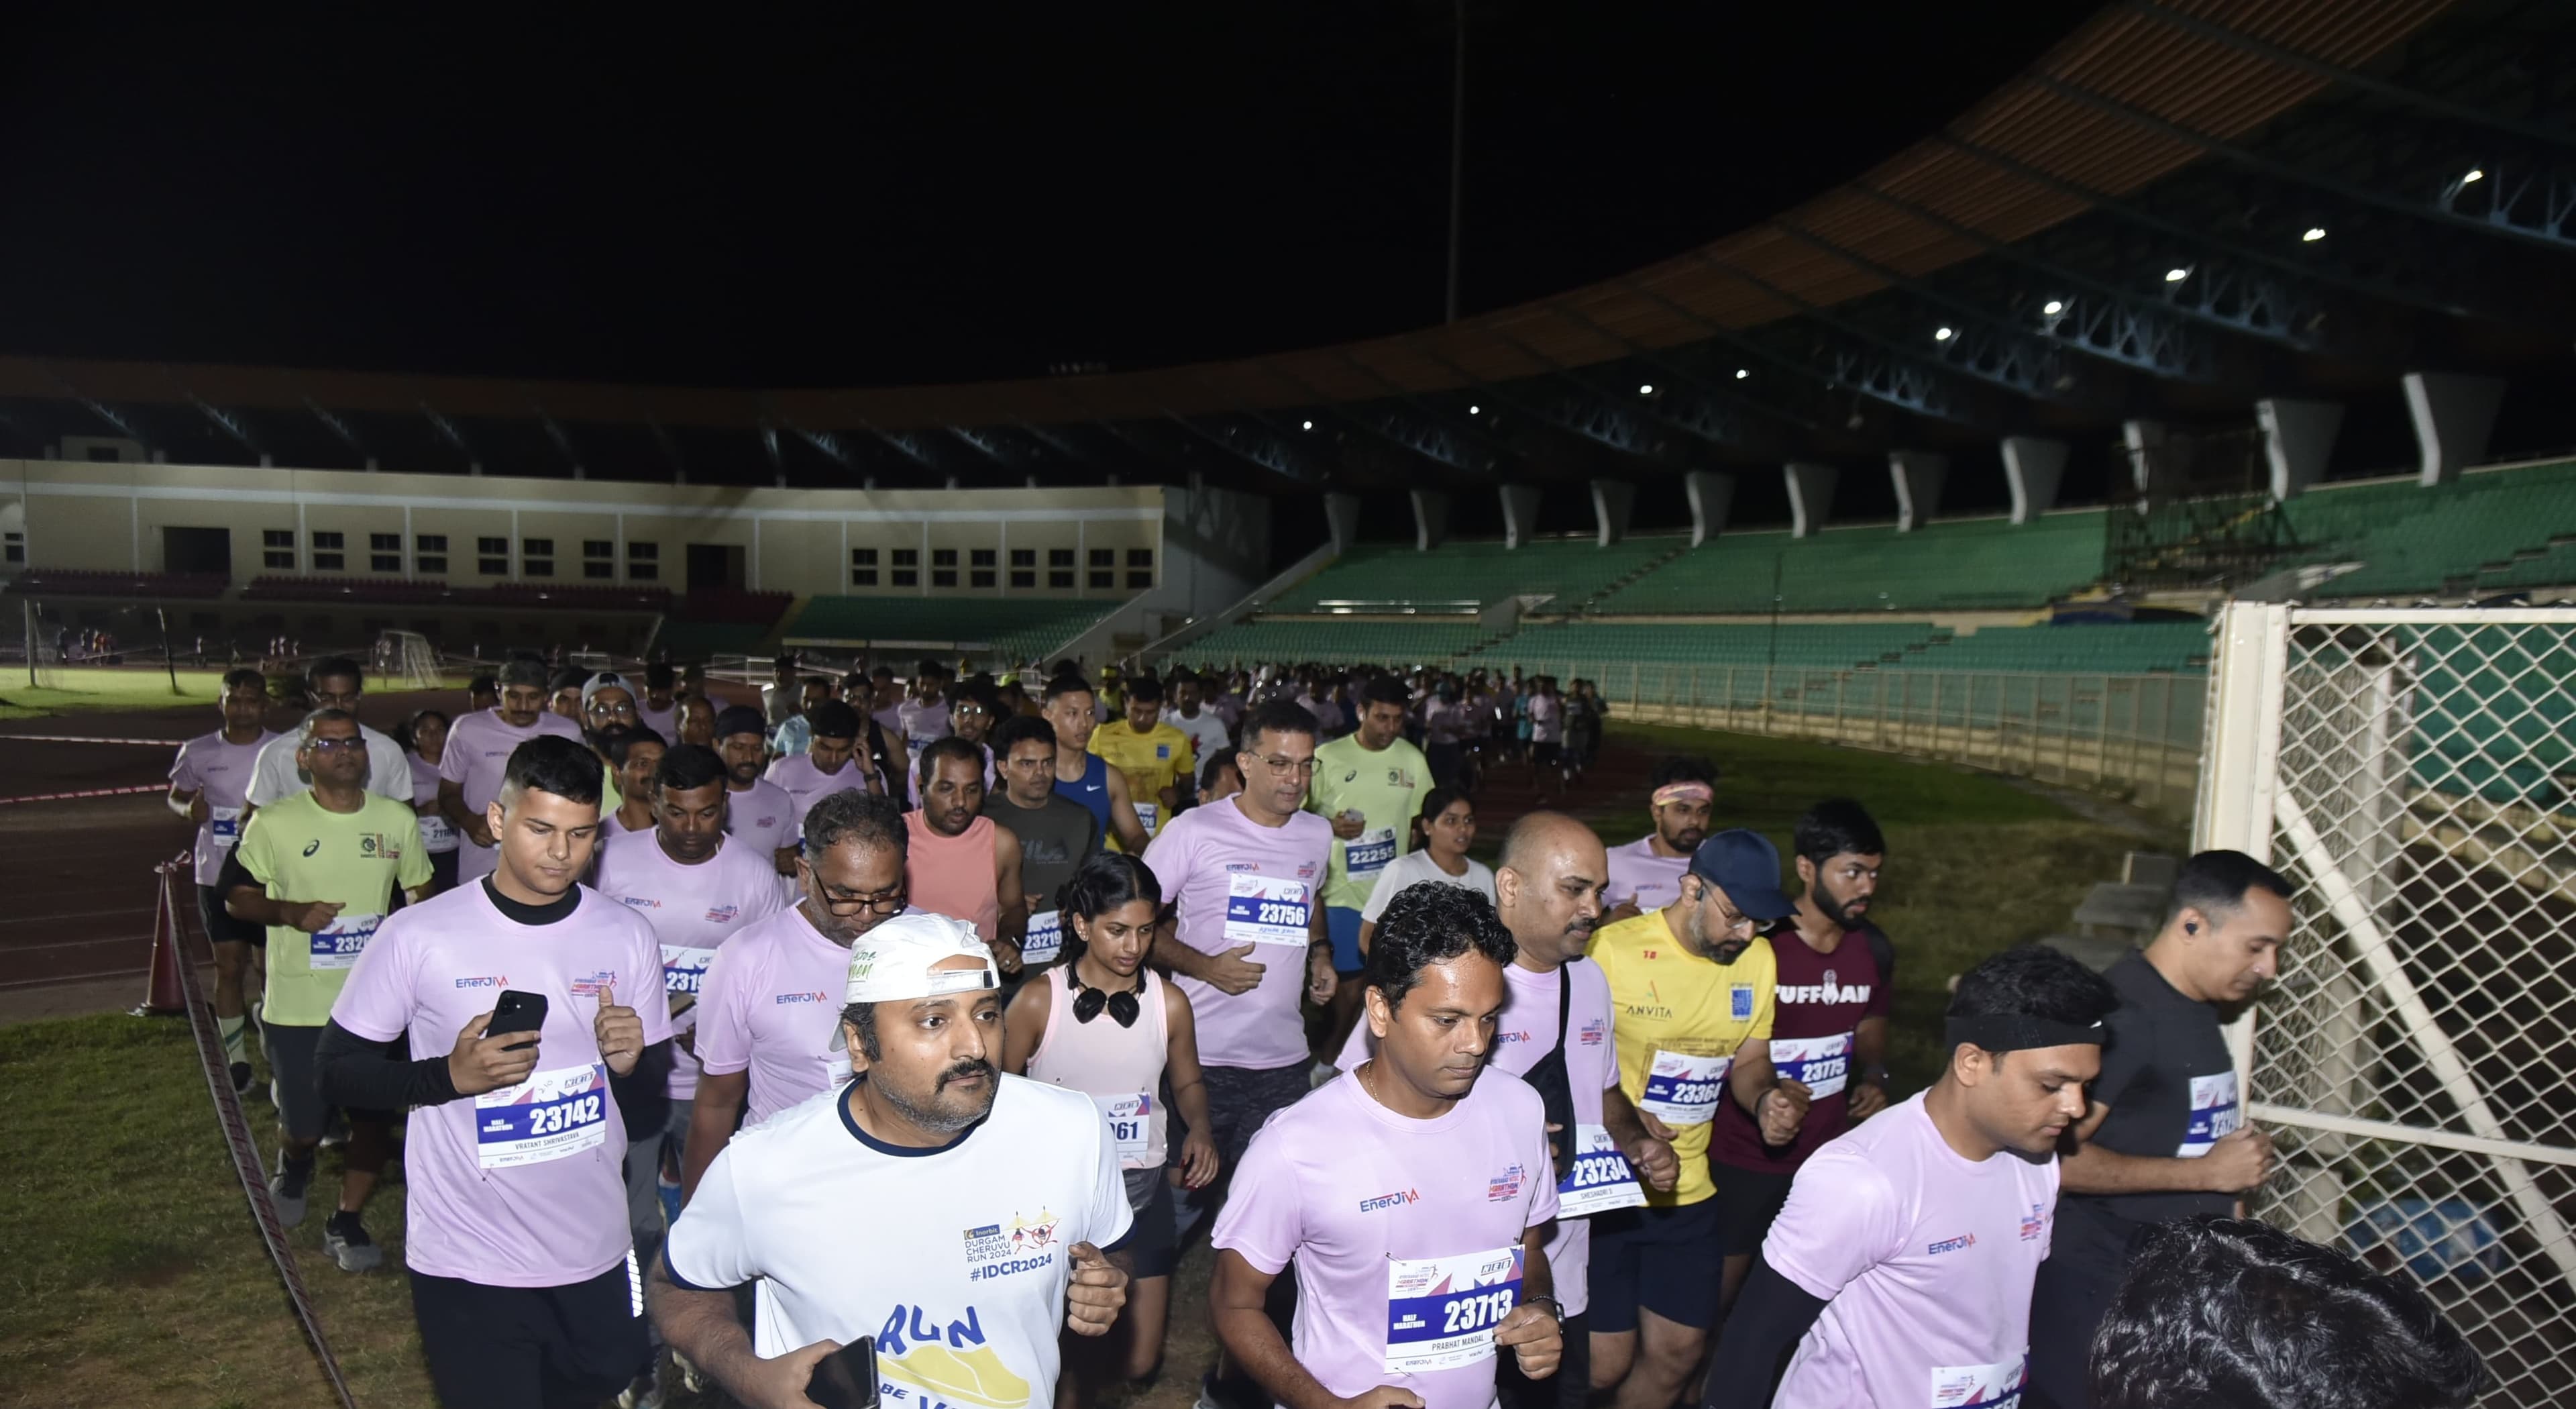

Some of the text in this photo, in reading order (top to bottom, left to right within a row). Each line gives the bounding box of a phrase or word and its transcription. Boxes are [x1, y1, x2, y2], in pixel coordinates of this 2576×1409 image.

[1350, 846, 1395, 865] 22255
[1258, 902, 1305, 926] 23756
[1024, 930, 1063, 949] 23219
[1626, 1005, 1672, 1019] ANVITA
[1801, 1057, 1846, 1082] 23775
[1671, 1082, 1723, 1104] 23364
[529, 1095, 600, 1135] 23742
[515, 1139, 542, 1150] VRATANT
[543, 1131, 580, 1147] SHRIVASTAVA
[1572, 1156, 1631, 1187] 23234
[975, 1227, 999, 1237] Inorbit
[965, 1235, 1006, 1249] DURGAM
[966, 1242, 1011, 1256] CHERUVU
[967, 1249, 1012, 1263] RUN 2024
[970, 1253, 1053, 1282] #IDCR2024
[1444, 1289, 1513, 1333] 23713
[875, 1304, 986, 1355] RUN
[1432, 1335, 1485, 1351] PRABHAT MANDAL
[880, 1382, 909, 1400] BE
